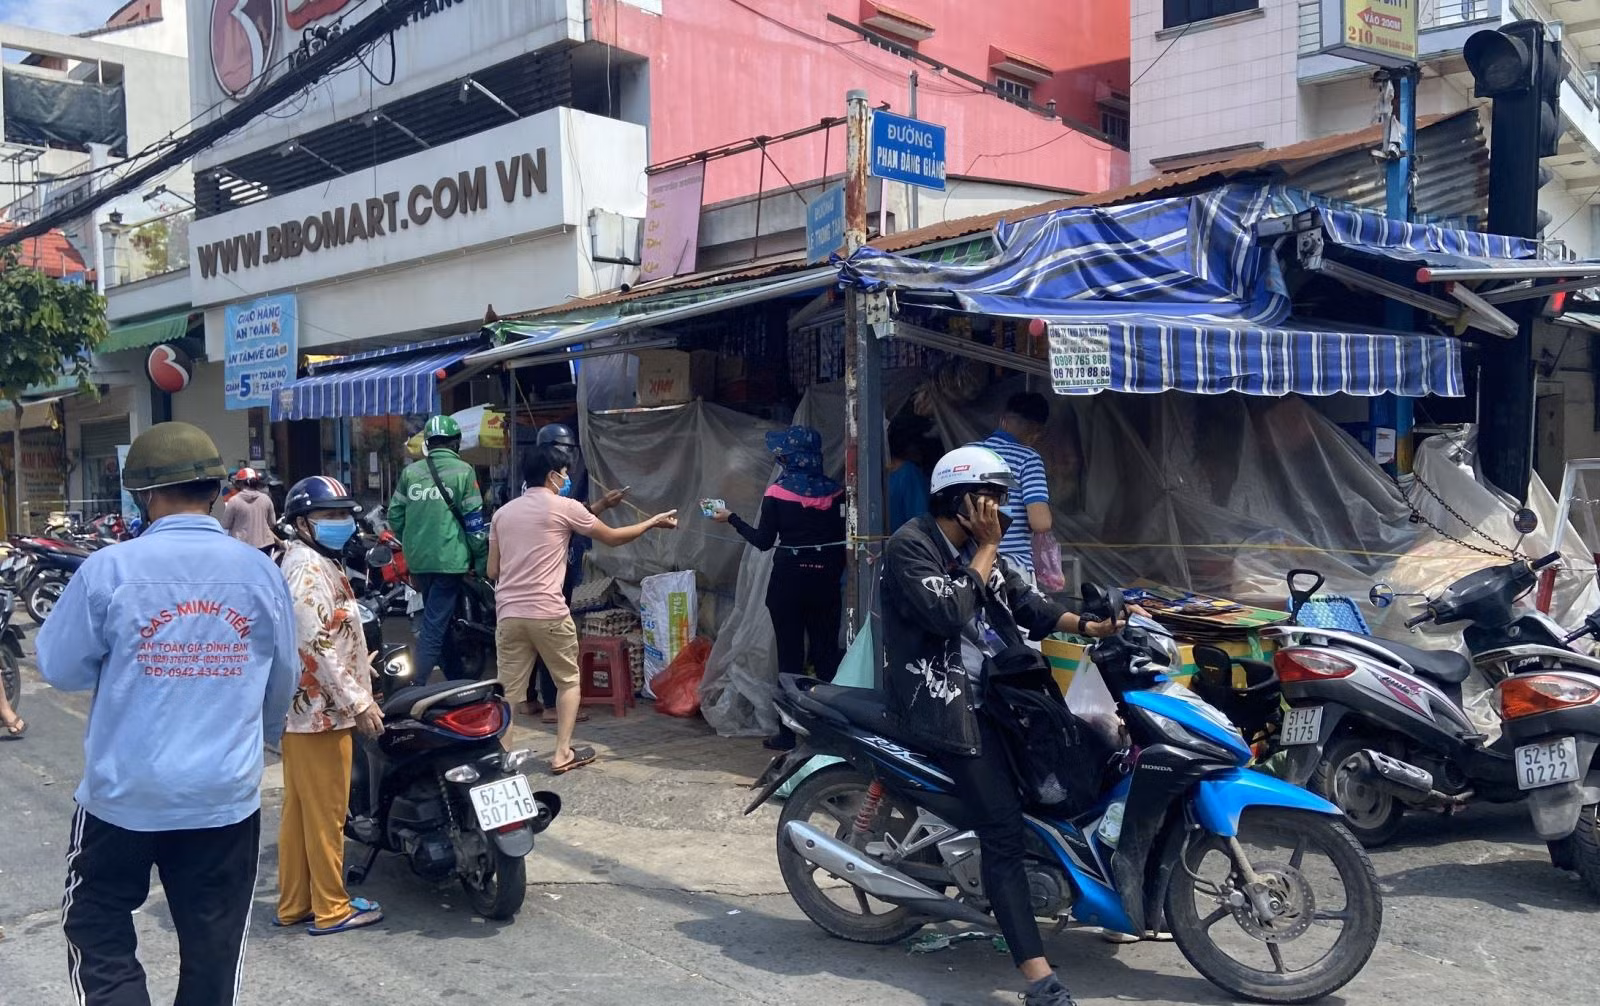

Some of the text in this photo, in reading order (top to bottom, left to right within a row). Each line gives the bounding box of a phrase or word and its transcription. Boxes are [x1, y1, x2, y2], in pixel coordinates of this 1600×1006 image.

[1348, 26, 1373, 45] 210
[887, 123, 933, 149] ĐƯỜNG
[877, 145, 899, 173] PHẠM
[923, 151, 946, 180] GIẢNG
[196, 147, 548, 279] WWW.BIBOMART.COM VN
[236, 328, 248, 340] AN
[239, 373, 251, 397] 5
[140, 600, 256, 640] GAS MINH TIẾN
[140, 642, 154, 651] AN
[159, 641, 185, 653] TOÀN
[1289, 709, 1316, 726] 51-L7
[1286, 725, 1314, 742] 5175
[1524, 742, 1566, 766] 52-F6
[1141, 763, 1174, 772] HONDA
[1526, 761, 1569, 785] 0222
[480, 780, 521, 807] 62-L1
[481, 798, 533, 826] 507.16
